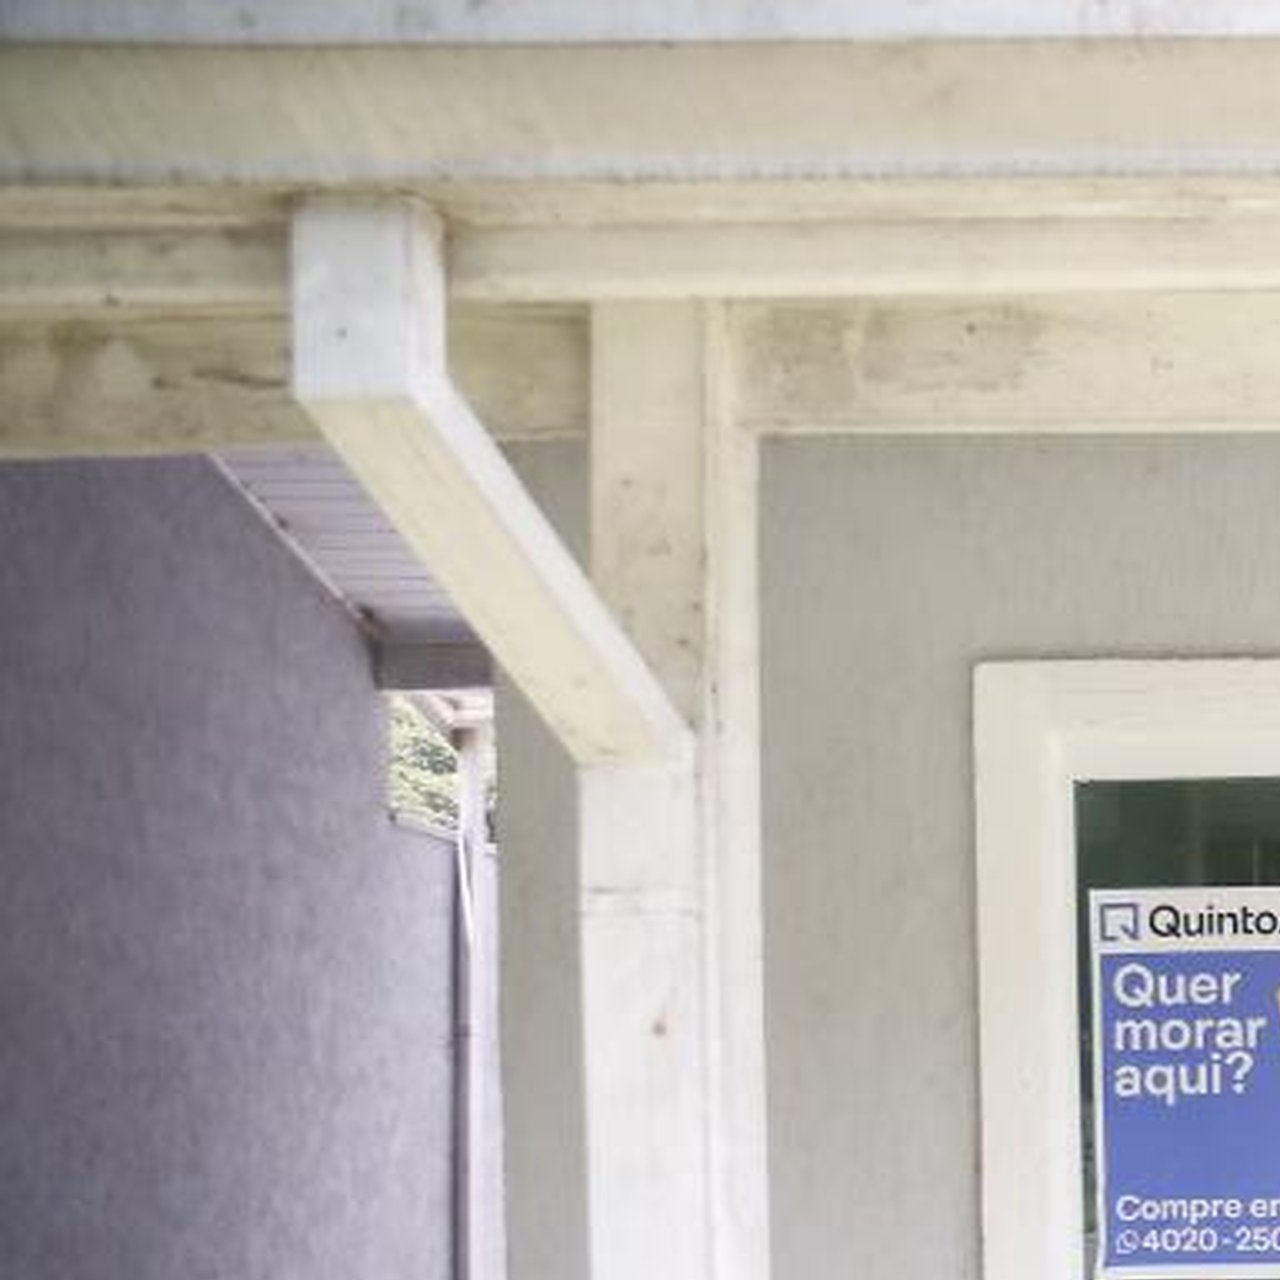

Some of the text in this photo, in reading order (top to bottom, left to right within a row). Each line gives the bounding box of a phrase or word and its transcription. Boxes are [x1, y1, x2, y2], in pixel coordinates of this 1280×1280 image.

[1114, 963, 1242, 1007] Quer
[1114, 1016, 1267, 1051] morar
[1114, 1051, 1254, 1105] aqui?
[1115, 1195, 1242, 1224] Compre
